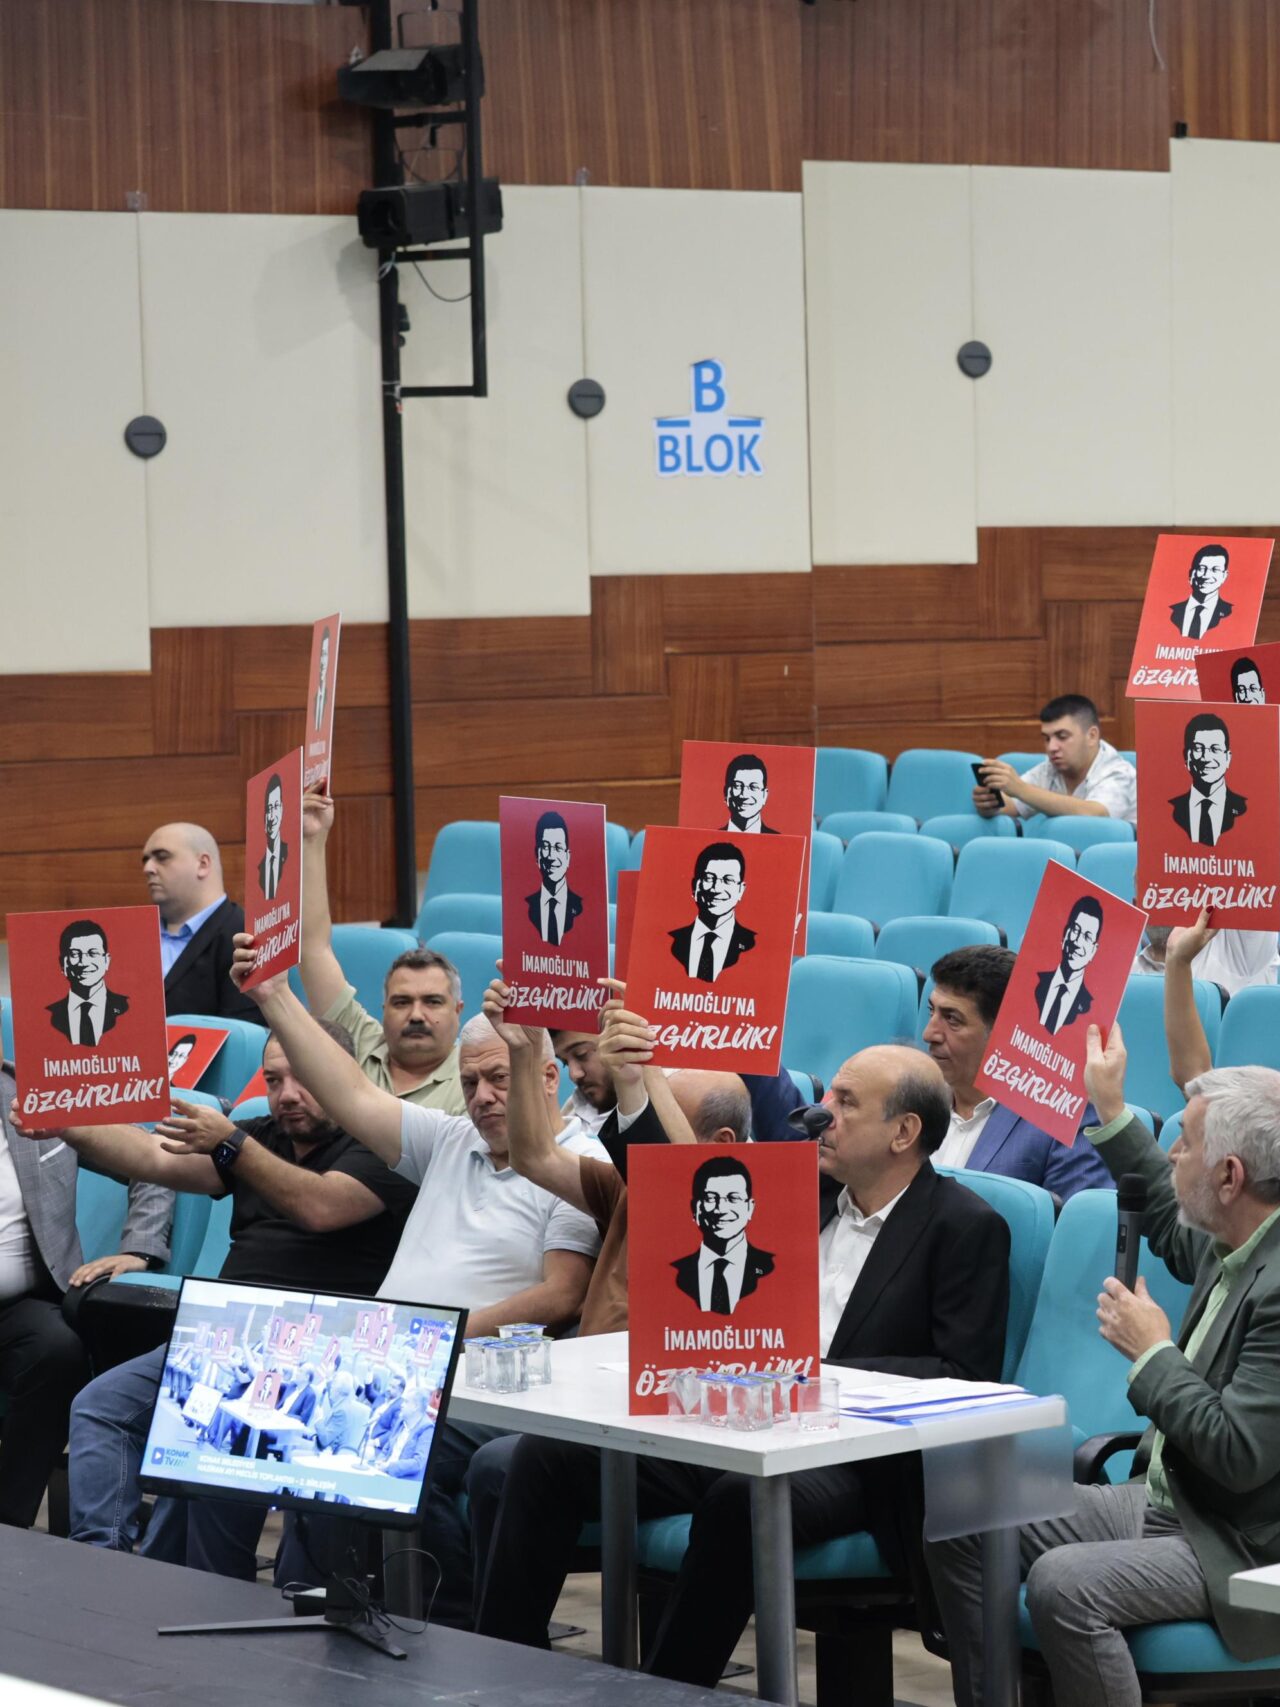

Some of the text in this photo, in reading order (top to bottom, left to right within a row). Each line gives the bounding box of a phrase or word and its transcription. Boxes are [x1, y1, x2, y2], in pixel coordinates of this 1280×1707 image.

[694, 360, 725, 412] B
[658, 434, 761, 472] BLOK
[1155, 643, 1224, 661] İMAMOĞ
[1132, 665, 1199, 687] ÖZGÜR
[1164, 853, 1255, 877] İMAMOĞLU'NA
[1142, 882, 1277, 911] ÖZGÜRLÜK!
[522, 951, 589, 979] İMAMOĞLU'NA
[654, 987, 755, 1017] İMAMOĞLU'NA
[648, 1021, 778, 1051] ZGÜRLÜK!
[44, 1055, 141, 1077] İMAMOĞLU'NA
[1010, 1024, 1075, 1082] İMAMOĞLU'NA
[23, 1077, 164, 1114] ÖZGÜRLÜK!
[983, 1049, 1083, 1119] ÖZGÜRLÜK!
[664, 1326, 785, 1350] İMAMOĞLU'NA
